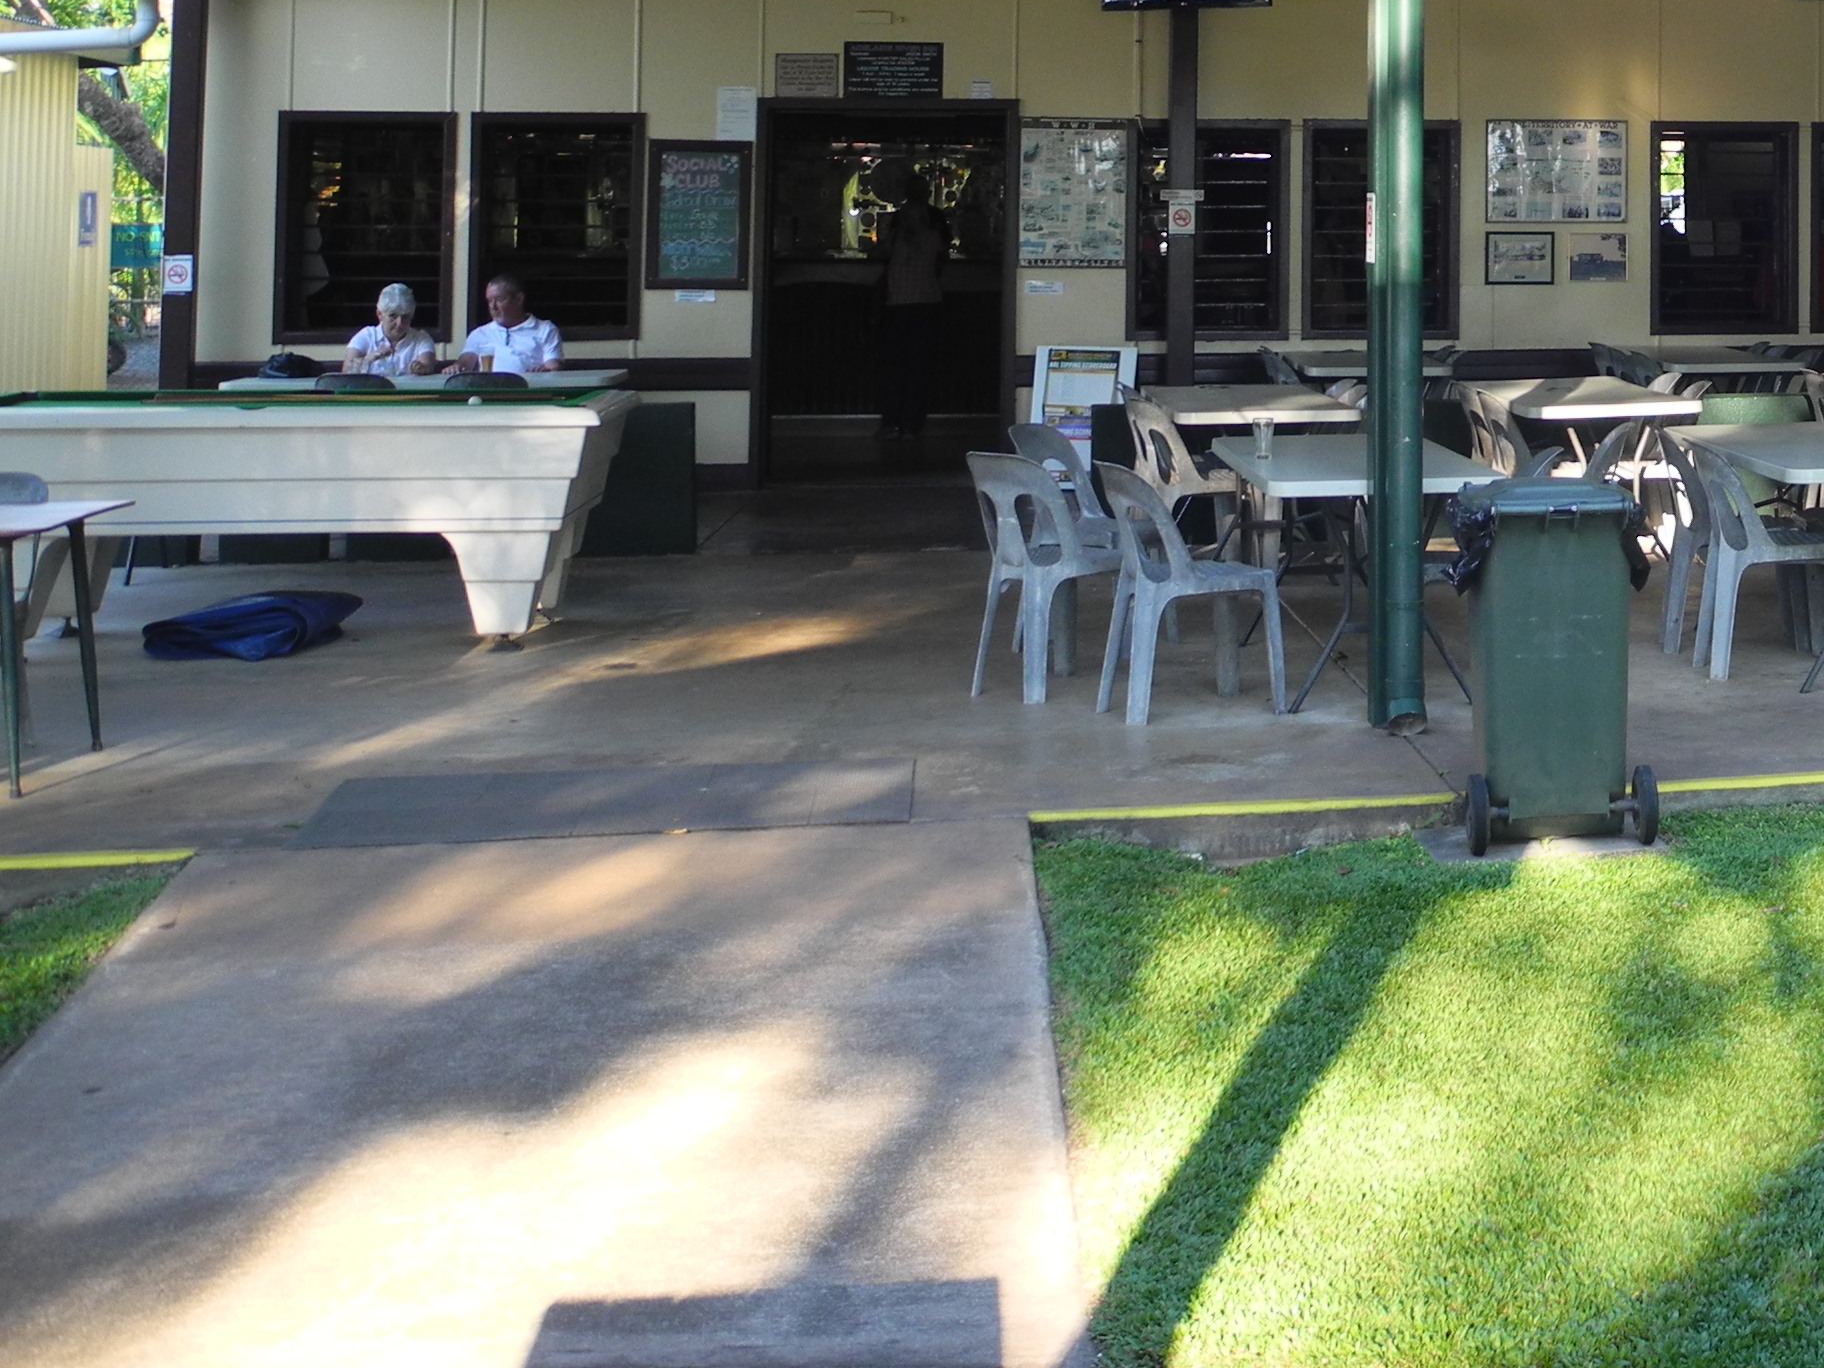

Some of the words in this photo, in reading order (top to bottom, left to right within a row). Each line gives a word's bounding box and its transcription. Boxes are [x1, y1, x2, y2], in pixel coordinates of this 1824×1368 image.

[1531, 121, 1577, 130] TERRITORY
[1600, 122, 1618, 130] WAR
[667, 154, 728, 173] SOCIAL
[676, 173, 721, 188] CLUB
